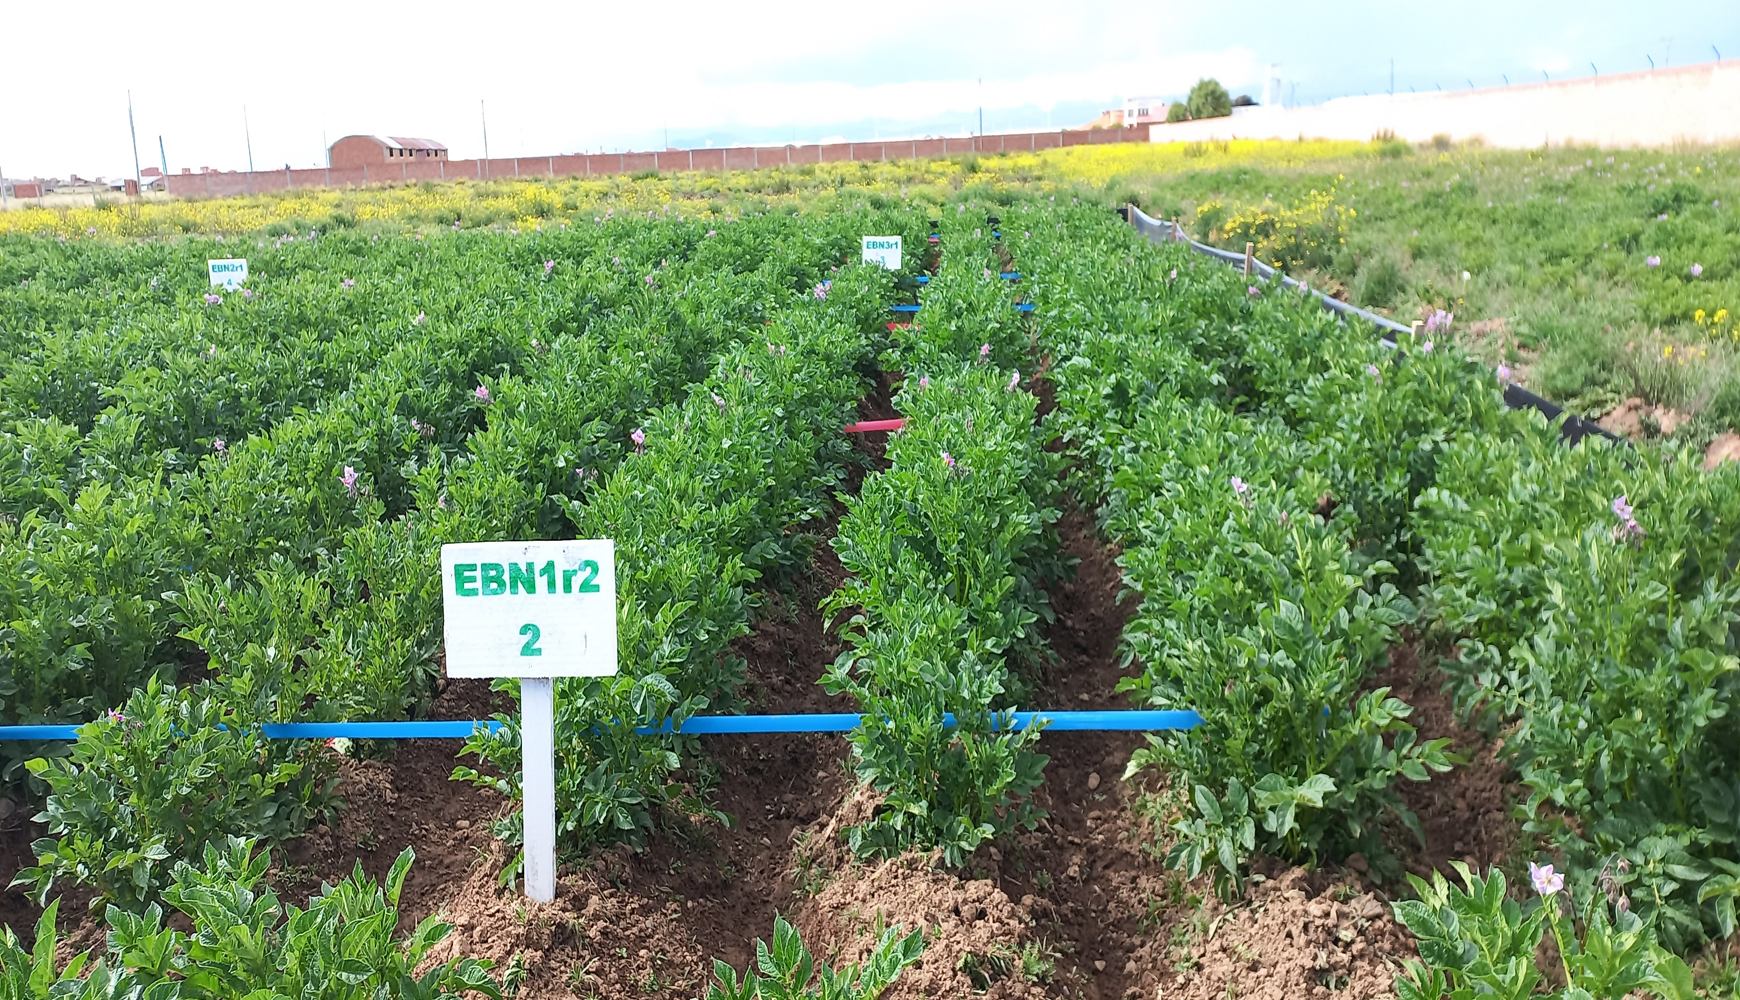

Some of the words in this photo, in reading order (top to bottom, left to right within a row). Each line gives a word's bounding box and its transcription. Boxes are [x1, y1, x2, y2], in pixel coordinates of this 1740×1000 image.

[866, 241, 898, 249] EBN3r1
[211, 264, 243, 272] EBN2r1
[454, 560, 600, 597] EBN1r2
[519, 623, 542, 656] 2
